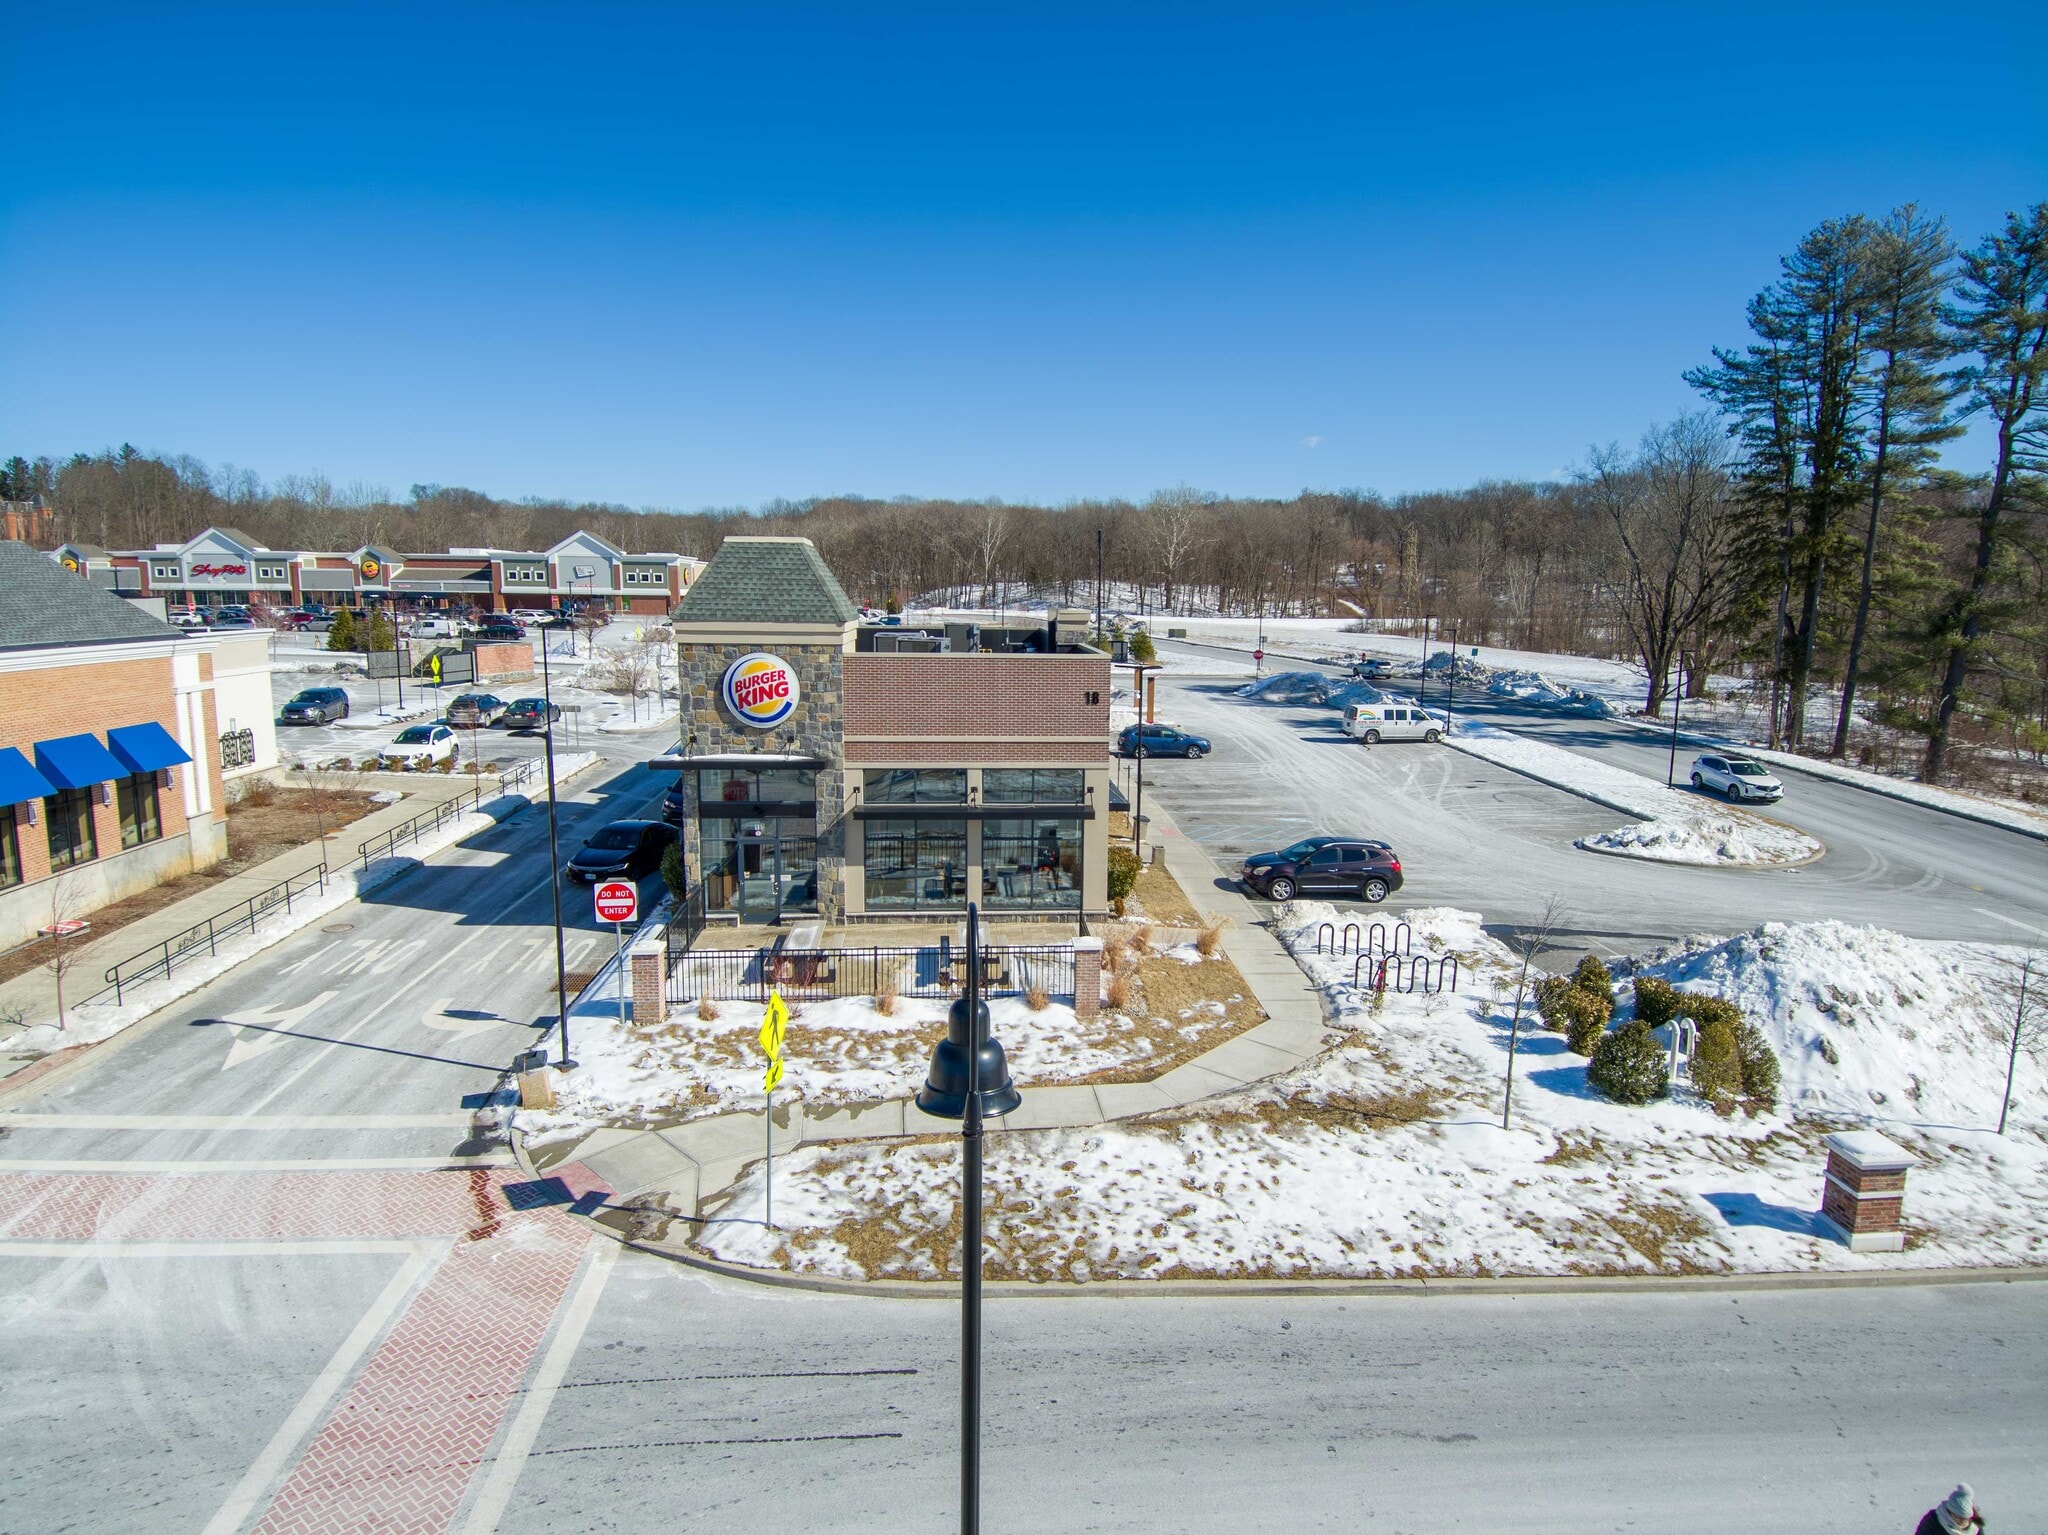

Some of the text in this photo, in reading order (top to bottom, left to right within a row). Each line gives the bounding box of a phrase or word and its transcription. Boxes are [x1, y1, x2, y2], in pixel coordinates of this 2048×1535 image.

[735, 670, 786, 693] BURGER
[738, 681, 789, 709] KING
[1084, 691, 1099, 705] 18
[276, 939, 427, 975] ONLY
